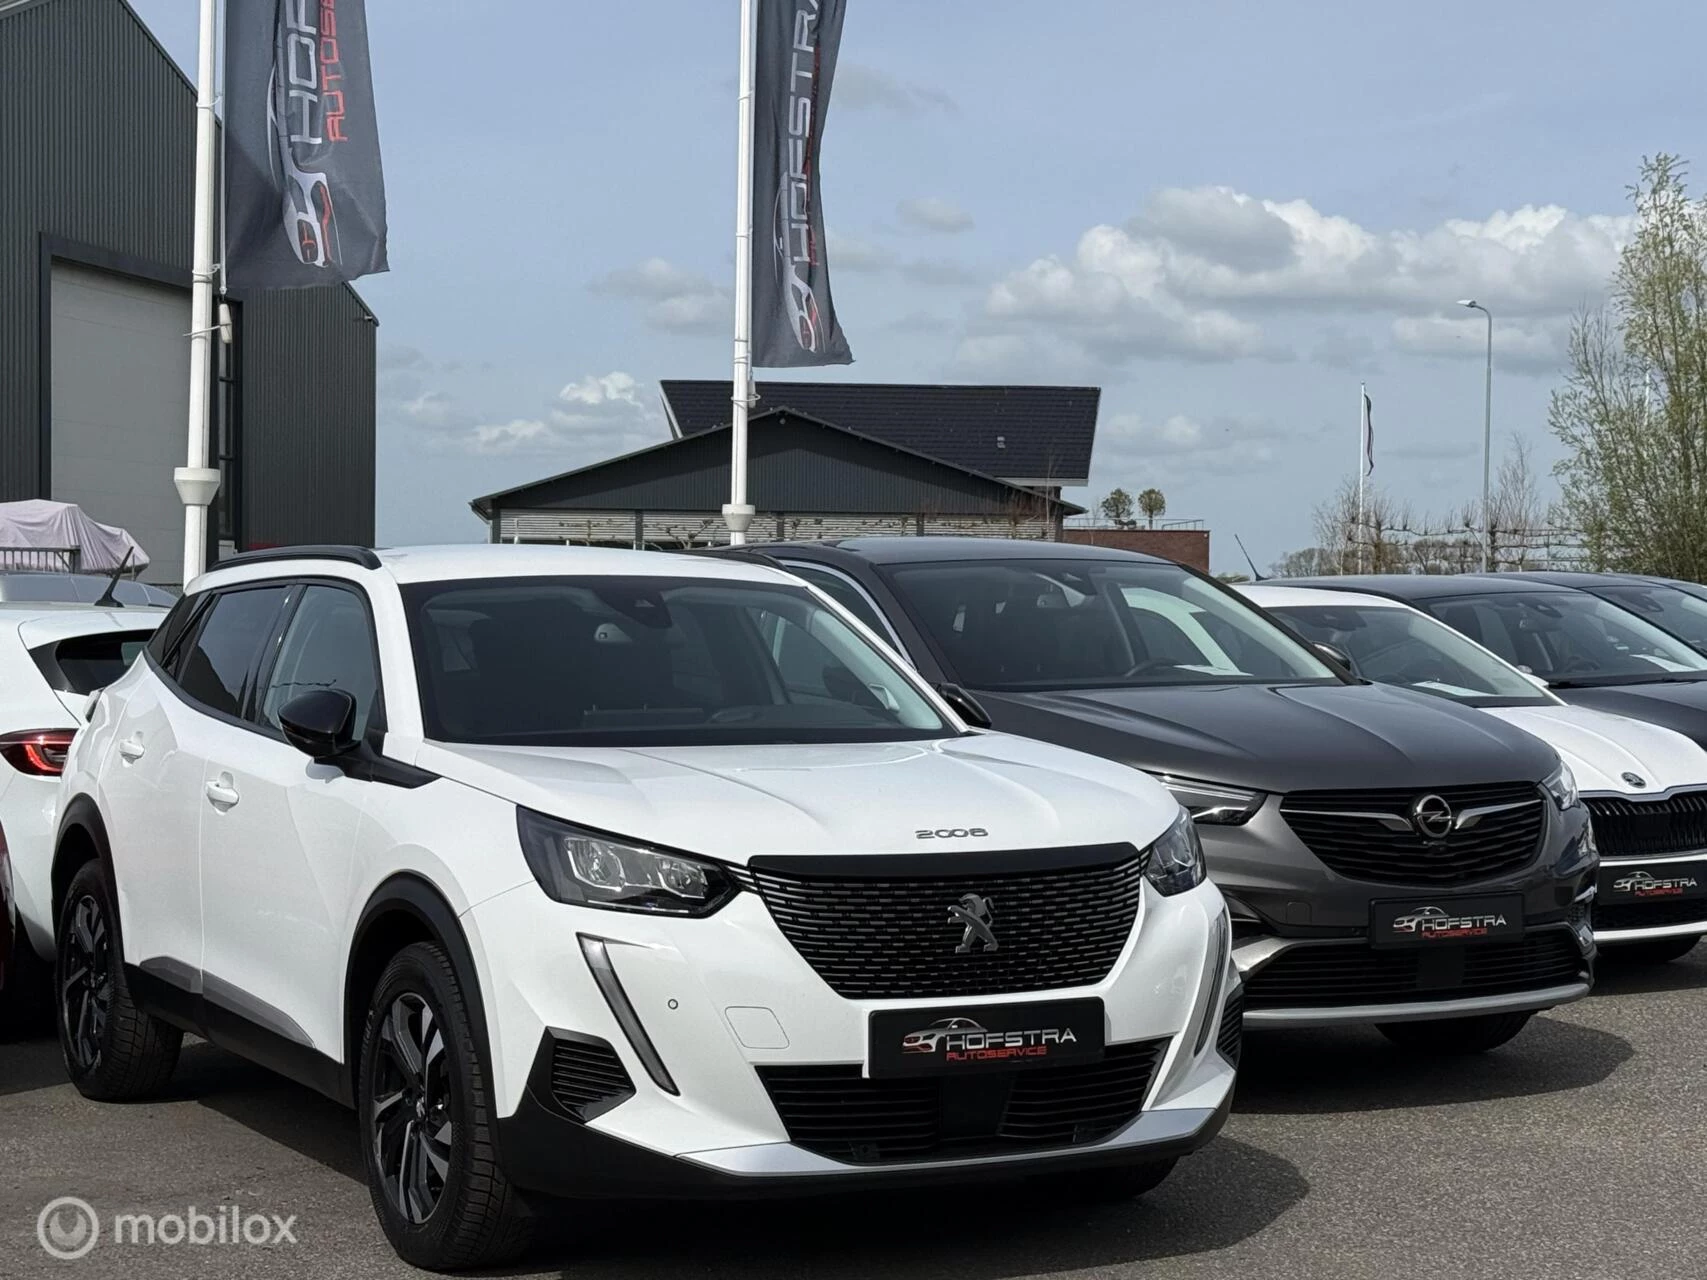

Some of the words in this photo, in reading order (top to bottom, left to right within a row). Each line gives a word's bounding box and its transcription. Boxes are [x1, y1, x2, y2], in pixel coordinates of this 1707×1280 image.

[319, 0, 349, 143] AUTOS
[787, 0, 819, 263] HOFSTR
[915, 828, 988, 840] 2008
[1634, 878, 1698, 891] HOFSTRA
[1421, 914, 1507, 931] HOFSTRA
[945, 1027, 1077, 1051] HOFSTRA
[945, 1046, 1048, 1061] AUTOSERVICE
